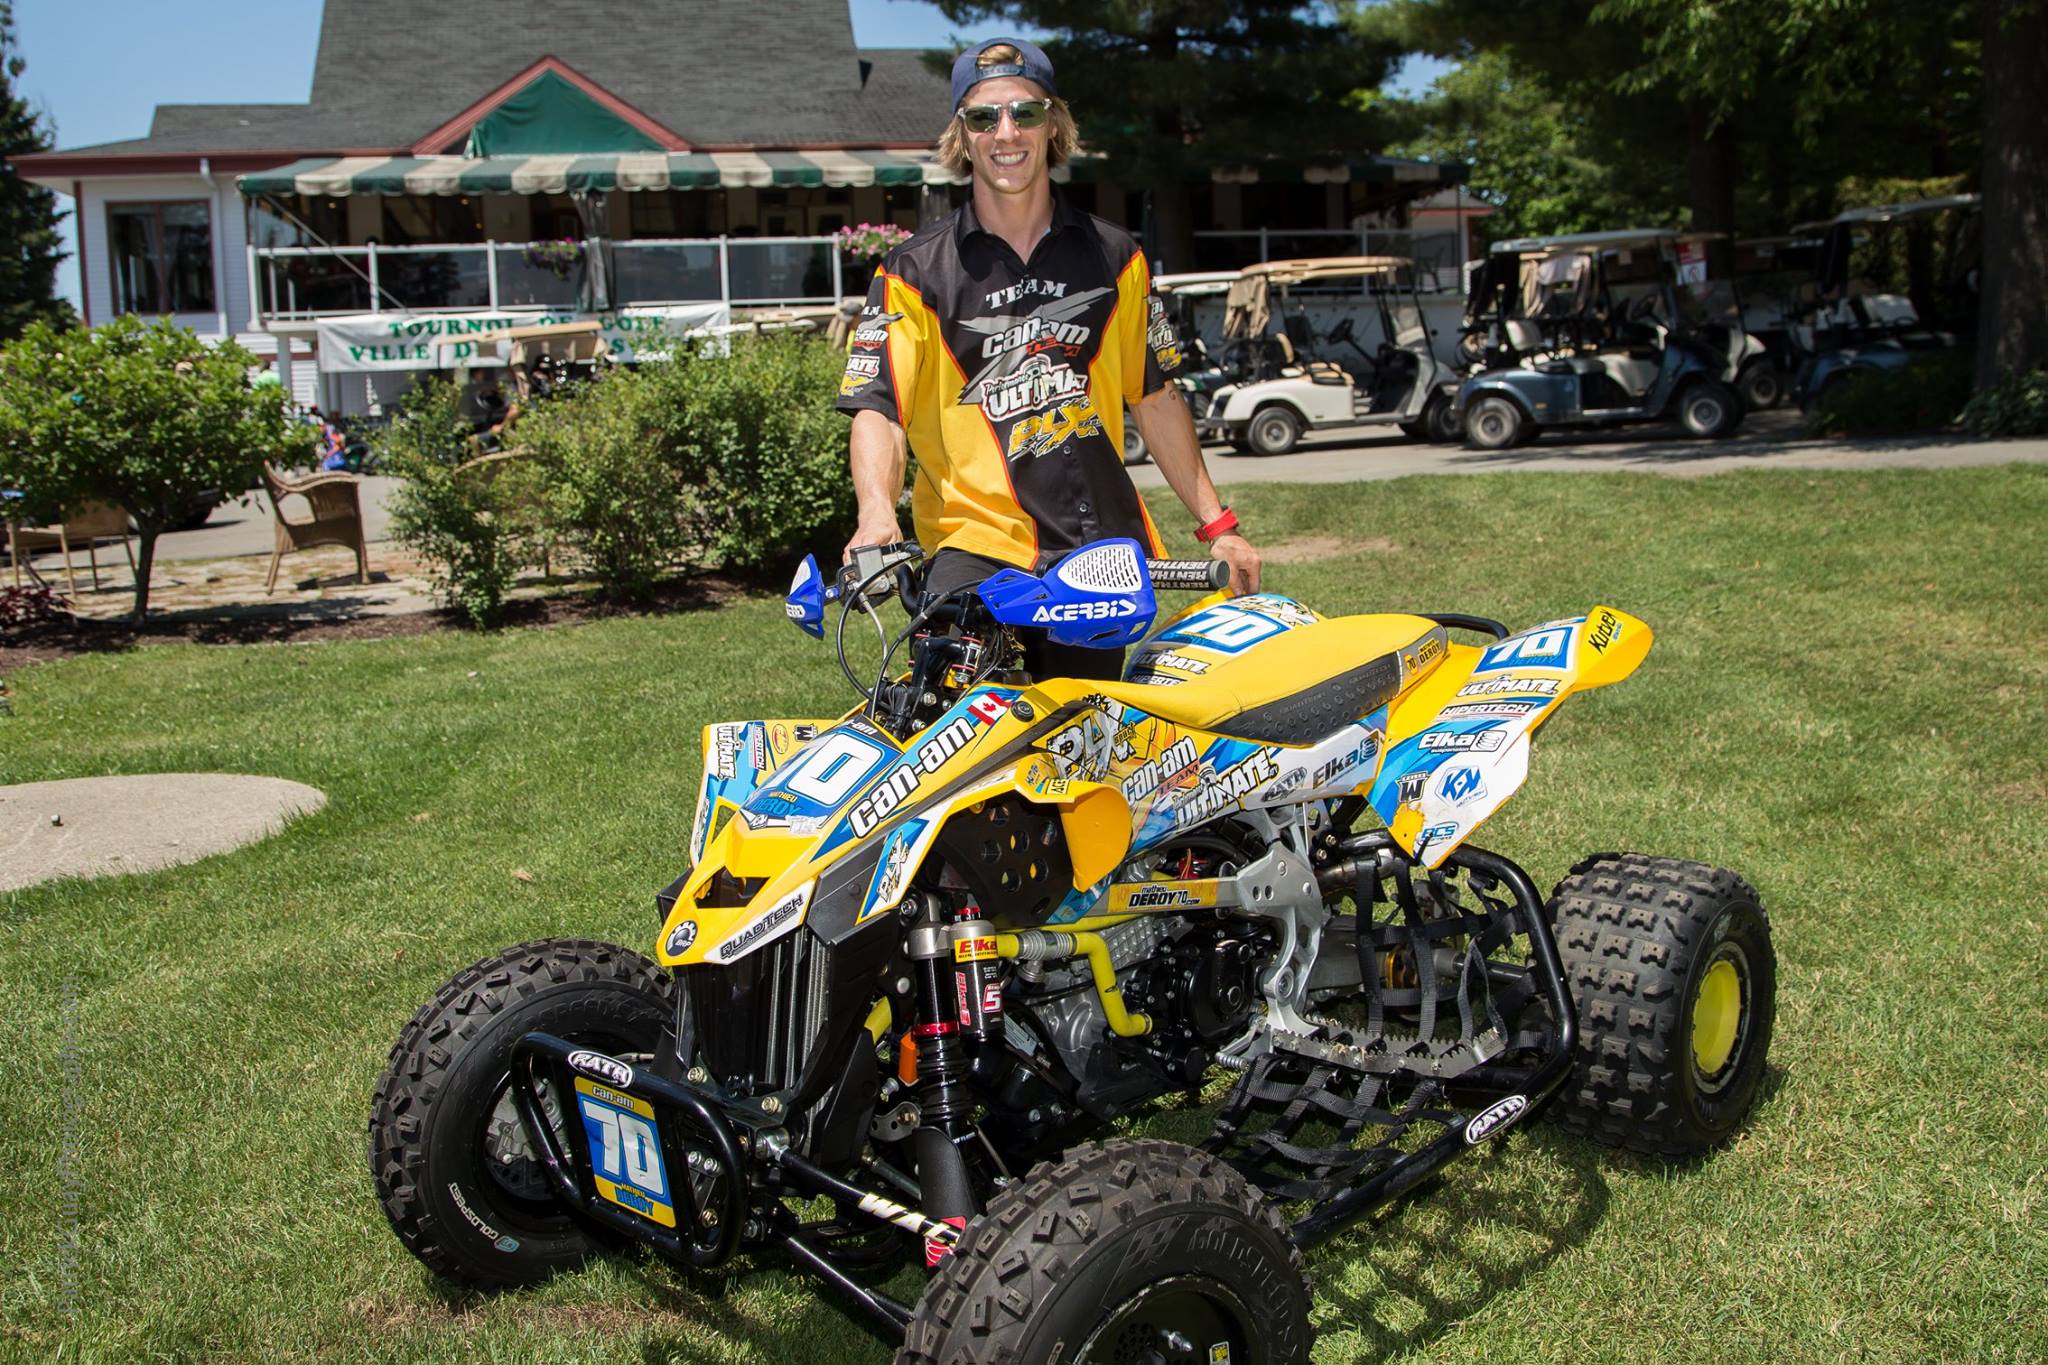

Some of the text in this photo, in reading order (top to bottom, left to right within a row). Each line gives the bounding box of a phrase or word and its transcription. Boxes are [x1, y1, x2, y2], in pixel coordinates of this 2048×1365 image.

[986, 278, 1067, 310] TEAM
[388, 318, 513, 338] TOURNOI
[600, 315, 664, 333] GOLF
[350, 343, 430, 362] VILLE
[1488, 627, 1563, 665] 70
[1444, 704, 1532, 715] HIPERTECH
[1418, 731, 1475, 750] Elka
[1313, 749, 1359, 789] Elka
[720, 894, 804, 959] QUADTECH
[959, 939, 998, 954] Elka
[574, 1054, 628, 1084] RATH
[1471, 1099, 1523, 1140] RATH
[582, 1100, 664, 1195] 70
[449, 1183, 499, 1240] GOLDSPEED
